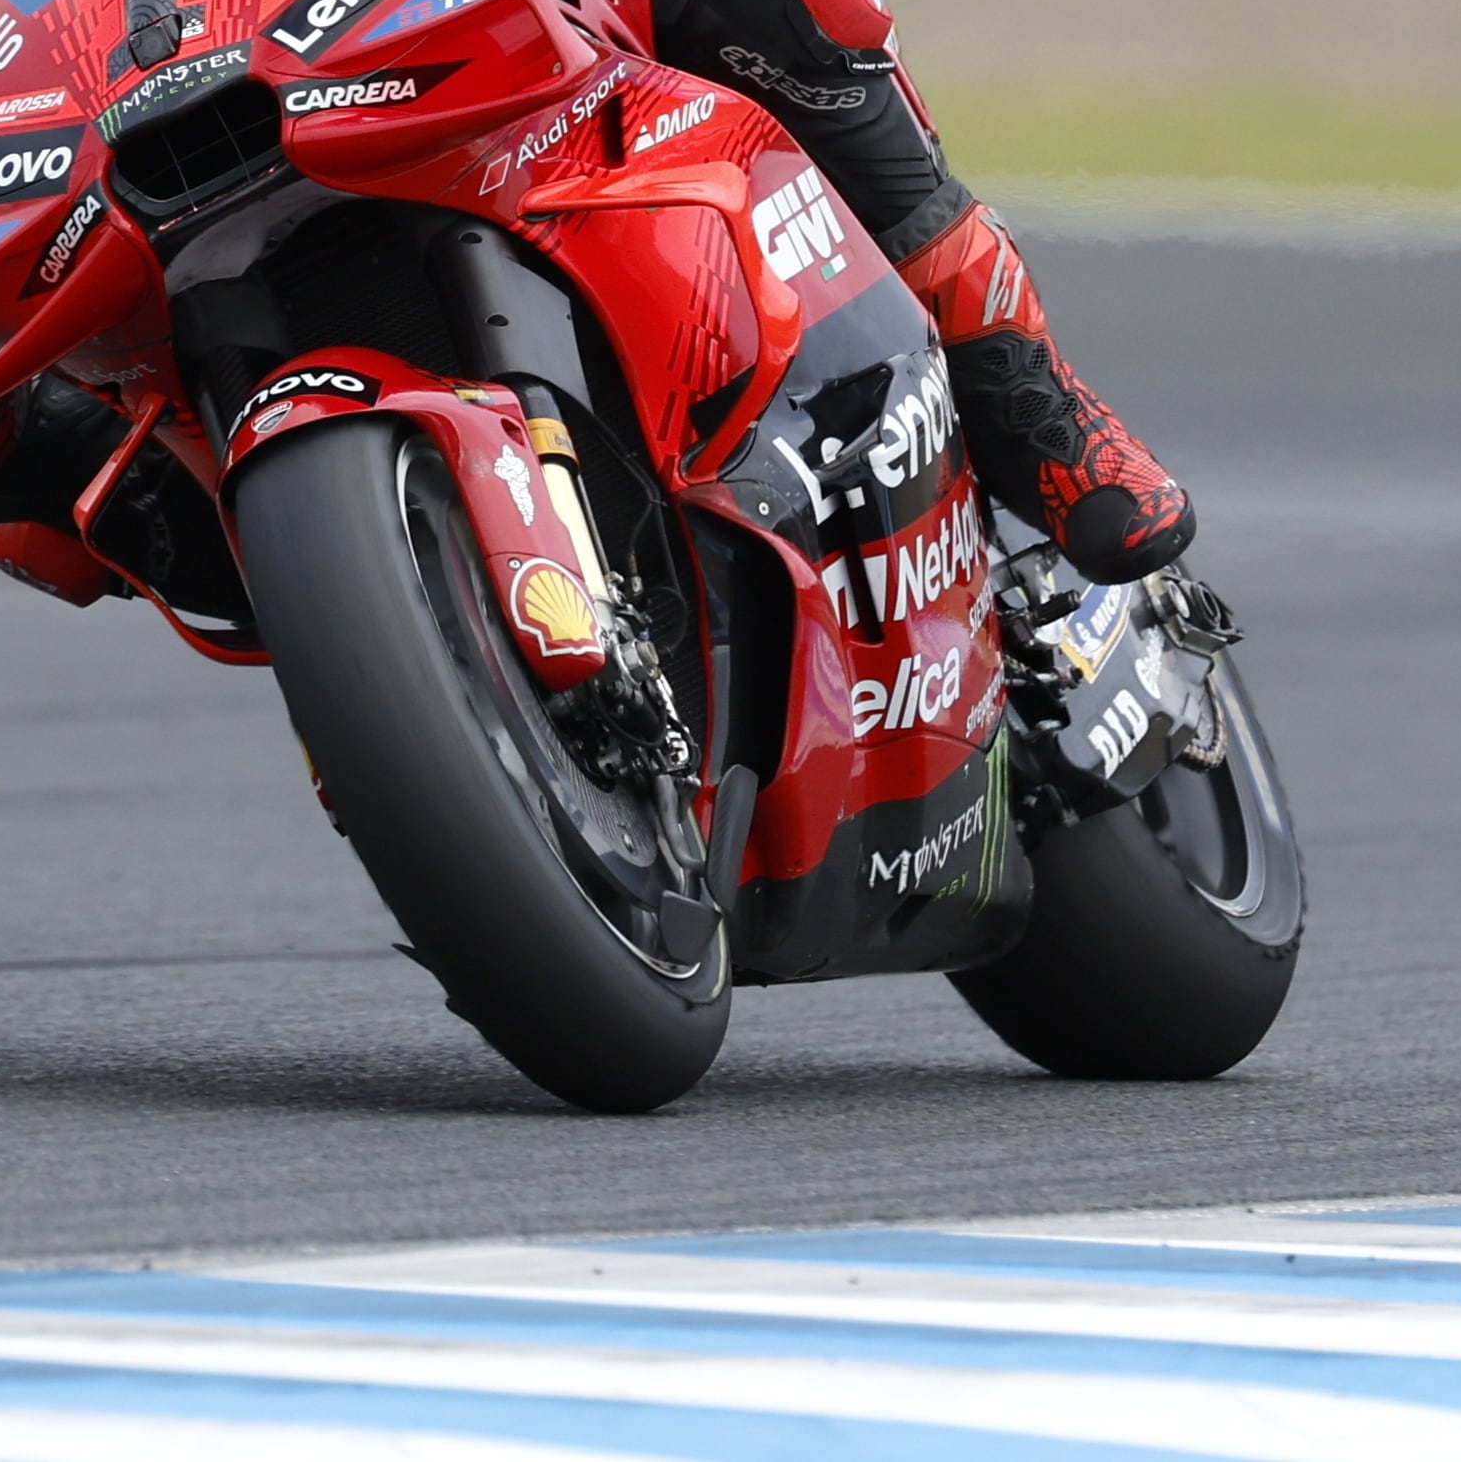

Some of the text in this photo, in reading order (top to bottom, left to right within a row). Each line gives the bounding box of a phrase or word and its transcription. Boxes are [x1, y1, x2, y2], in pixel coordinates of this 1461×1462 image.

[121, 49, 248, 114] MONSTER
[141, 71, 227, 112] ENERGY
[285, 77, 417, 113] CARRERA
[720, 46, 867, 110] alpinestars
[515, 60, 628, 169] Audi Sport
[654, 92, 716, 144] DAIKO
[39, 193, 102, 285] CARRERA
[751, 165, 846, 284] GIVI
[227, 372, 366, 440] enovo
[850, 646, 961, 739] elica
[869, 794, 985, 895] MONSTER
